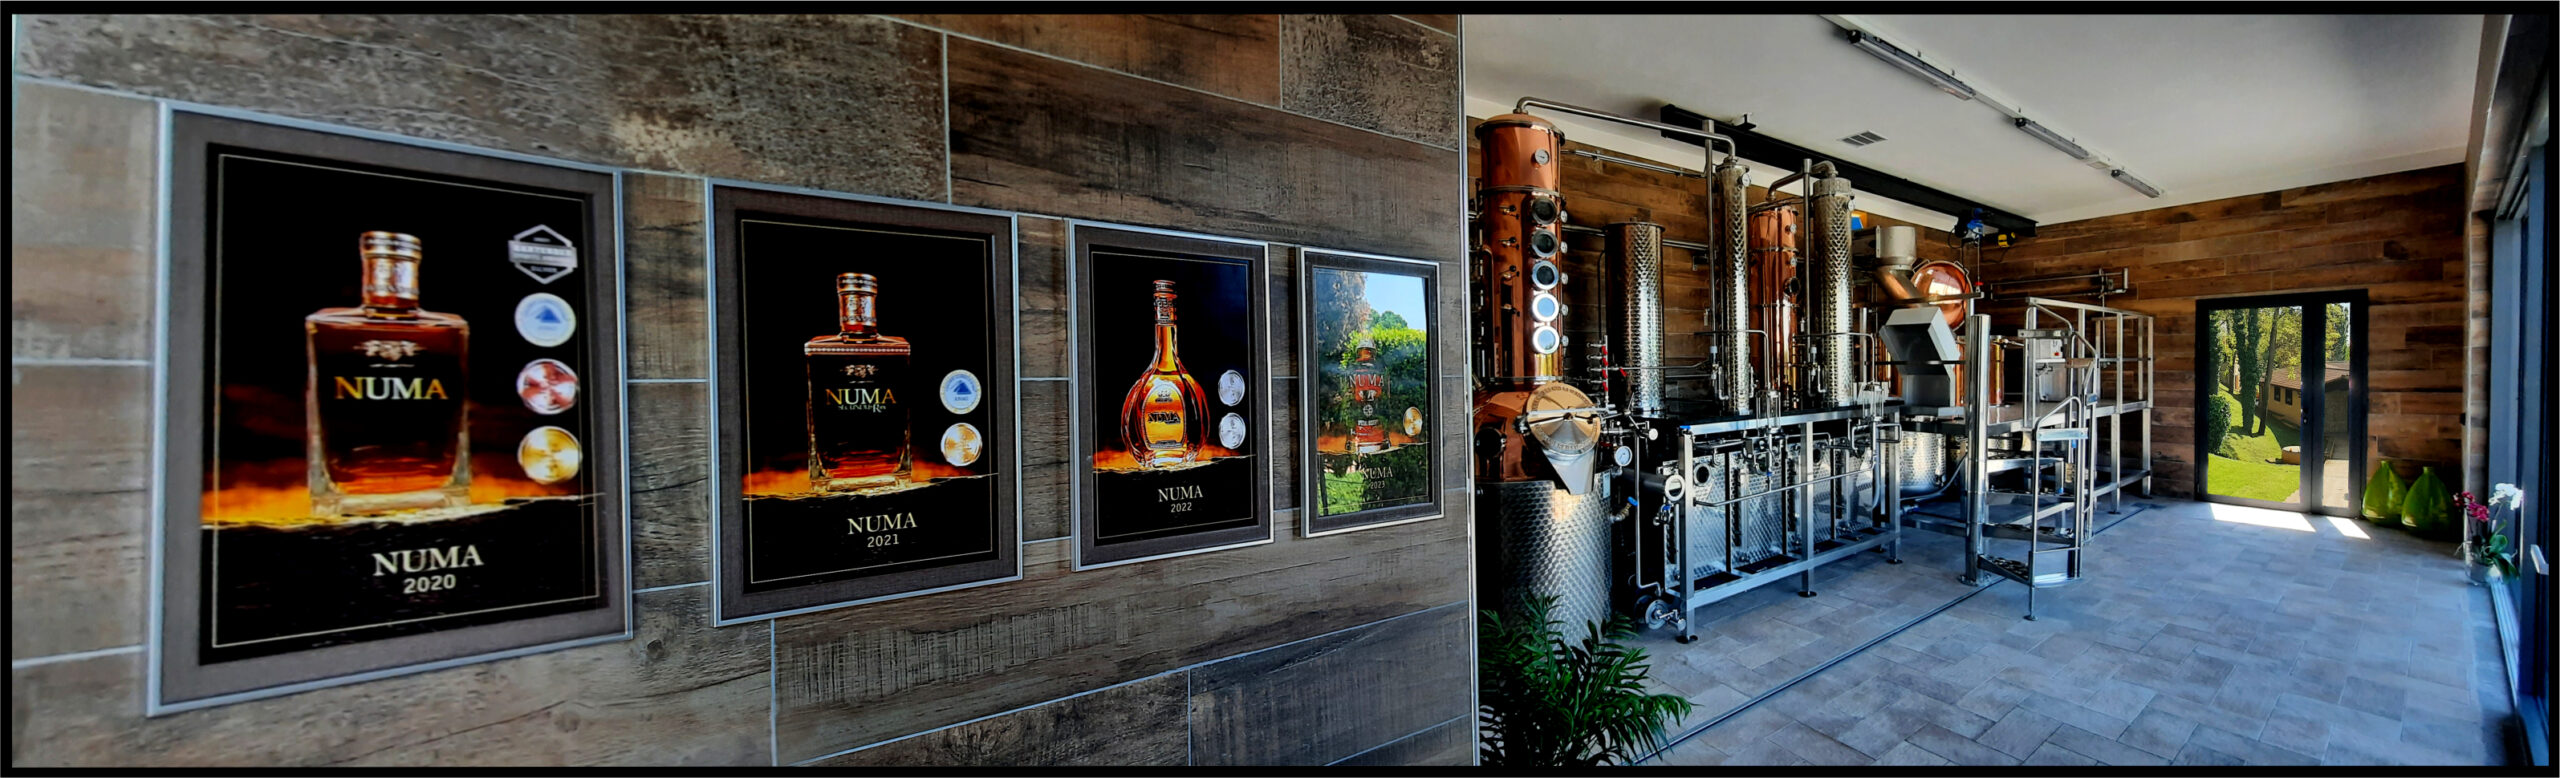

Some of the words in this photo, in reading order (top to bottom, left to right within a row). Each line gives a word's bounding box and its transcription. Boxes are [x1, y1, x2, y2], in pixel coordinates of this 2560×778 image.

[334, 376, 448, 400] NUMA
[1349, 374, 1384, 388] NUMA
[825, 388, 897, 405] NUMA
[1158, 485, 1203, 502] NUMA
[1370, 481, 1385, 489] 2023
[1171, 502, 1192, 513] 2022
[847, 512, 918, 534] NUMA
[867, 534, 899, 548] 2021
[371, 544, 485, 577] NUMA
[403, 574, 456, 594] 2020
